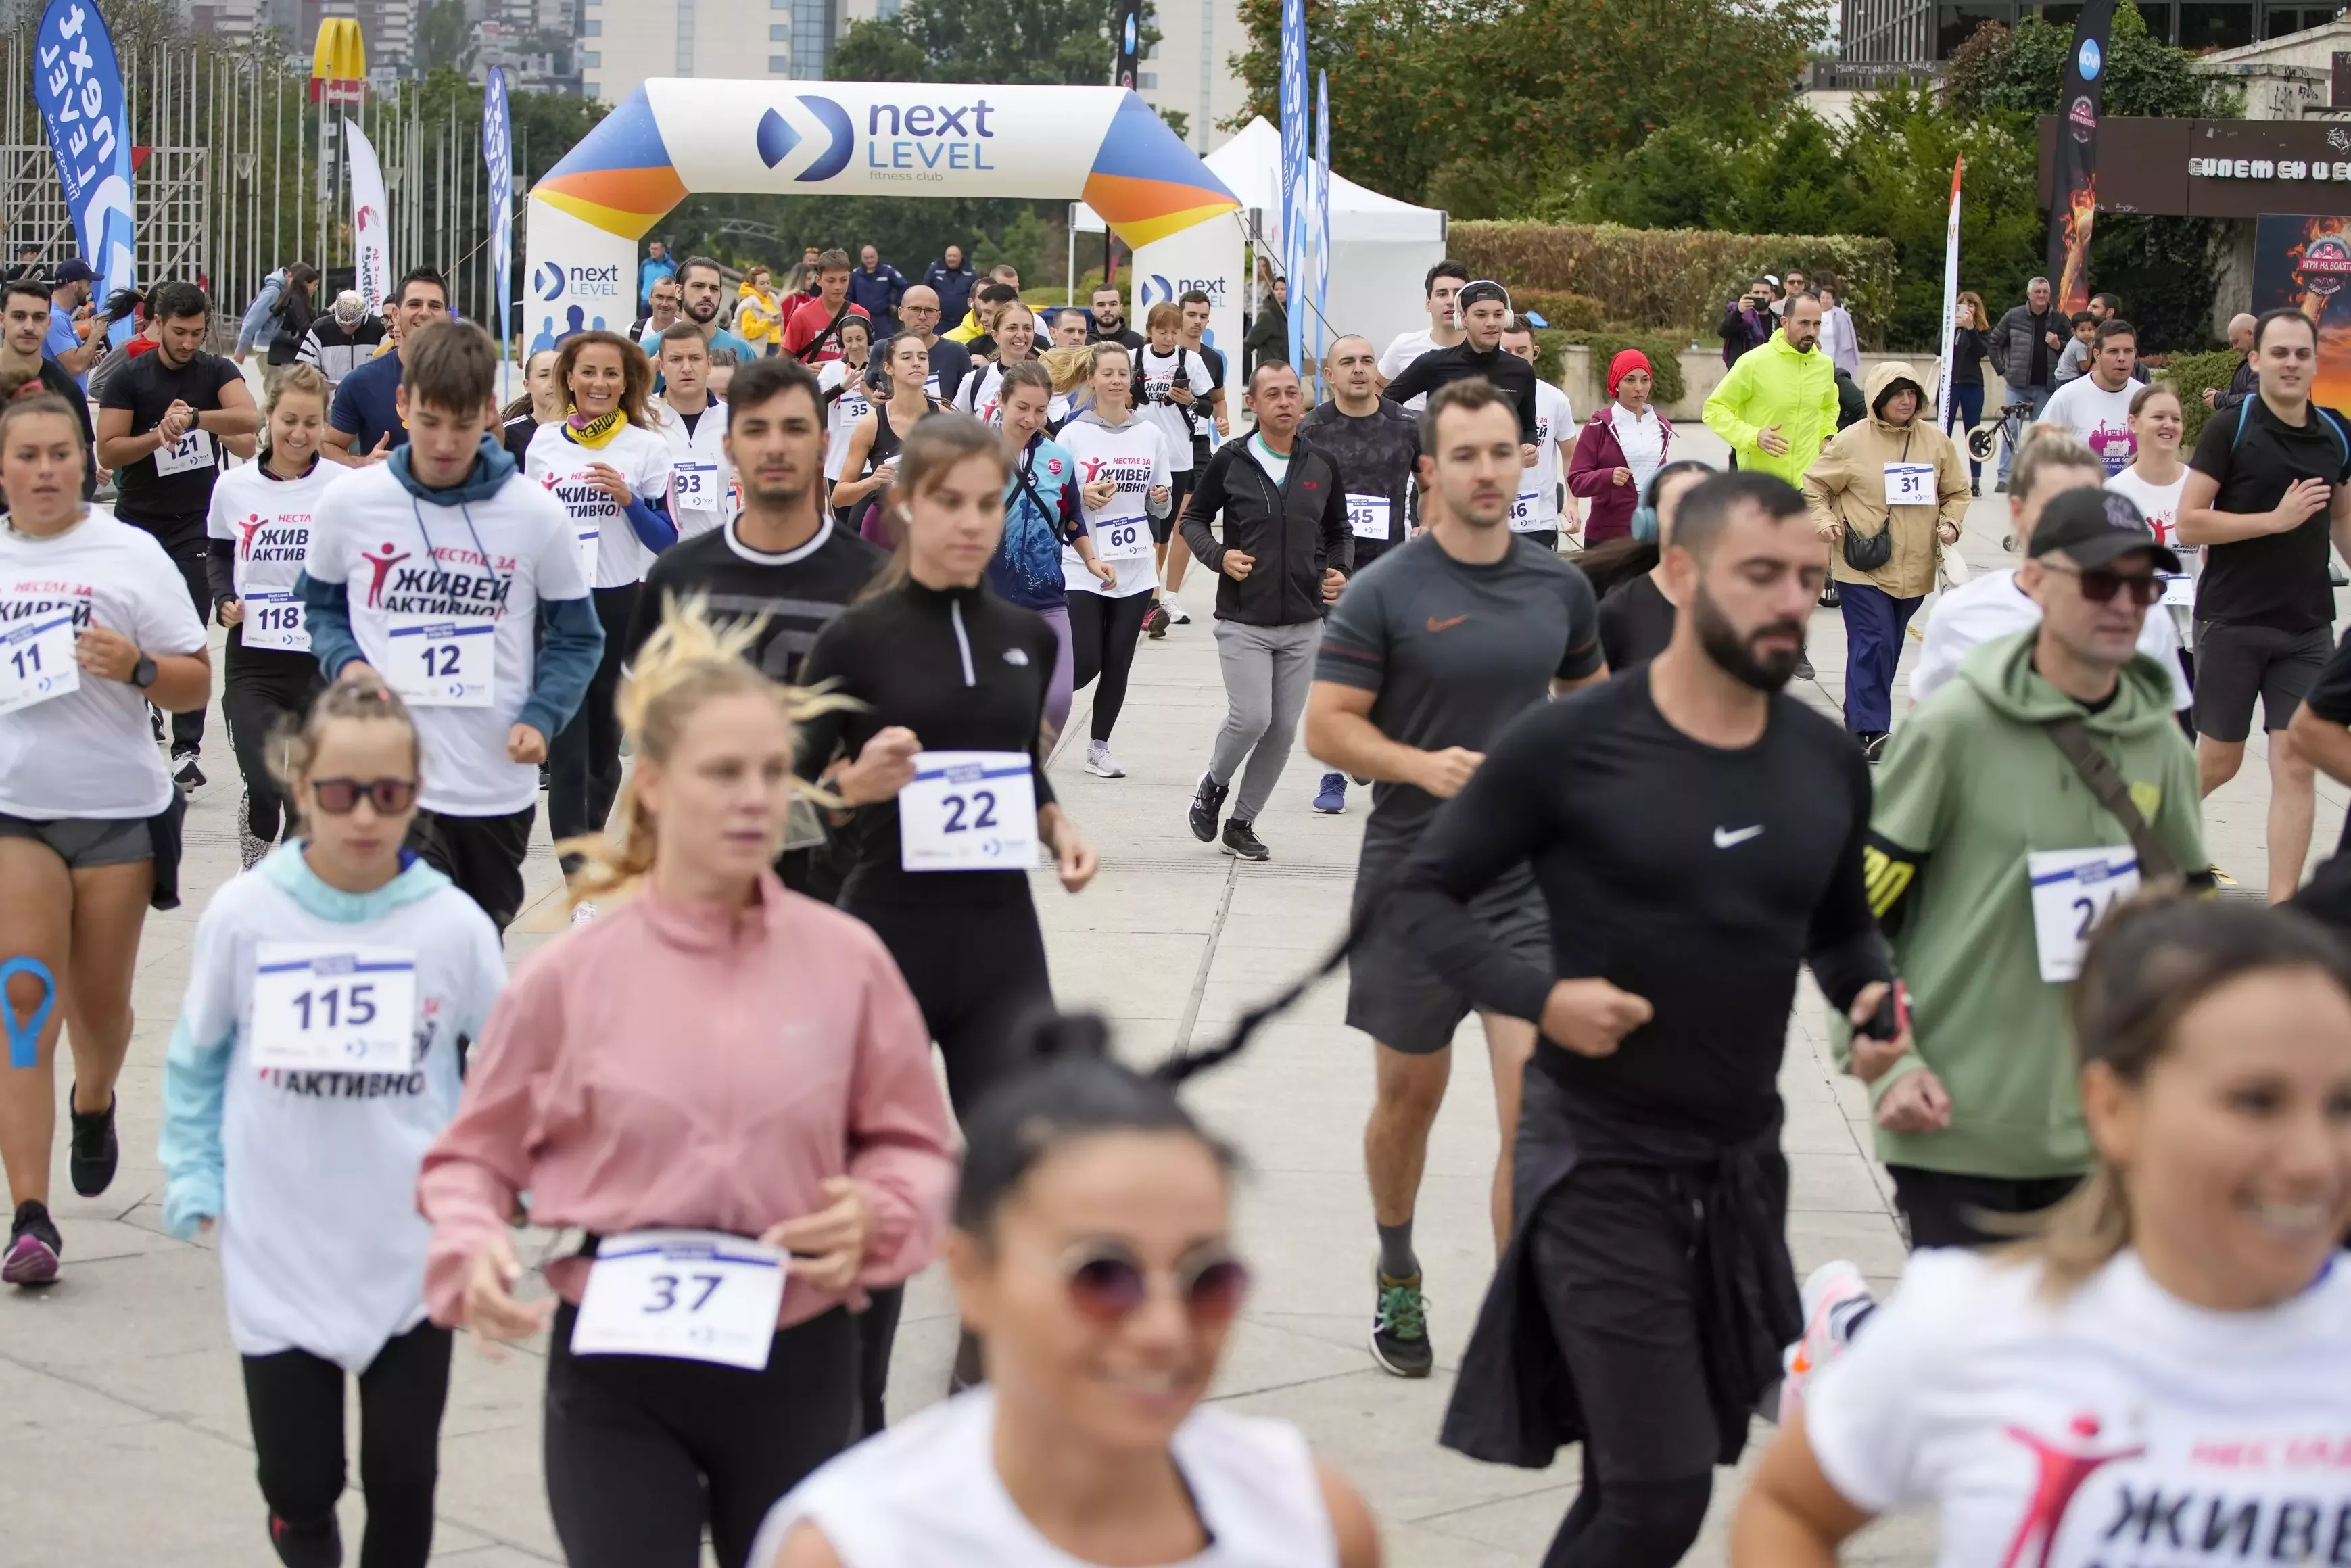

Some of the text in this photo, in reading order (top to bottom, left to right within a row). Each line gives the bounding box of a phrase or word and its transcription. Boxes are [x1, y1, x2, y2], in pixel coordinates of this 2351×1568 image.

[2079, 51, 2101, 68] NOVA
[869, 99, 995, 137] next
[869, 141, 995, 170] LEVEL
[870, 170, 943, 181] fitness club
[571, 264, 619, 281] next
[2303, 260, 2318, 269] ИГРИ
[2320, 262, 2329, 270] НА
[570, 283, 618, 295] LEVEL
[1179, 276, 1226, 293] next
[851, 404, 868, 417] 35
[1100, 467, 1151, 482] ЖИВЕЙ
[676, 475, 701, 494] 93
[1901, 476, 1919, 492] 31
[278, 514, 311, 523] НЕСТЛ
[1348, 509, 1374, 524] 45
[1507, 502, 1527, 519] 46
[258, 529, 308, 545] ЖИВ
[1111, 527, 1136, 546] 60
[252, 548, 306, 561] АКТИВ
[427, 547, 516, 570] НЕСТЛЕ ЗА
[394, 569, 513, 602] ЖИВЕЙ
[258, 607, 298, 630] 118
[11, 643, 41, 679] 11
[421, 645, 460, 677] 12
[942, 790, 997, 833] 22
[293, 984, 376, 1030] 115
[642, 1273, 723, 1312] 37
